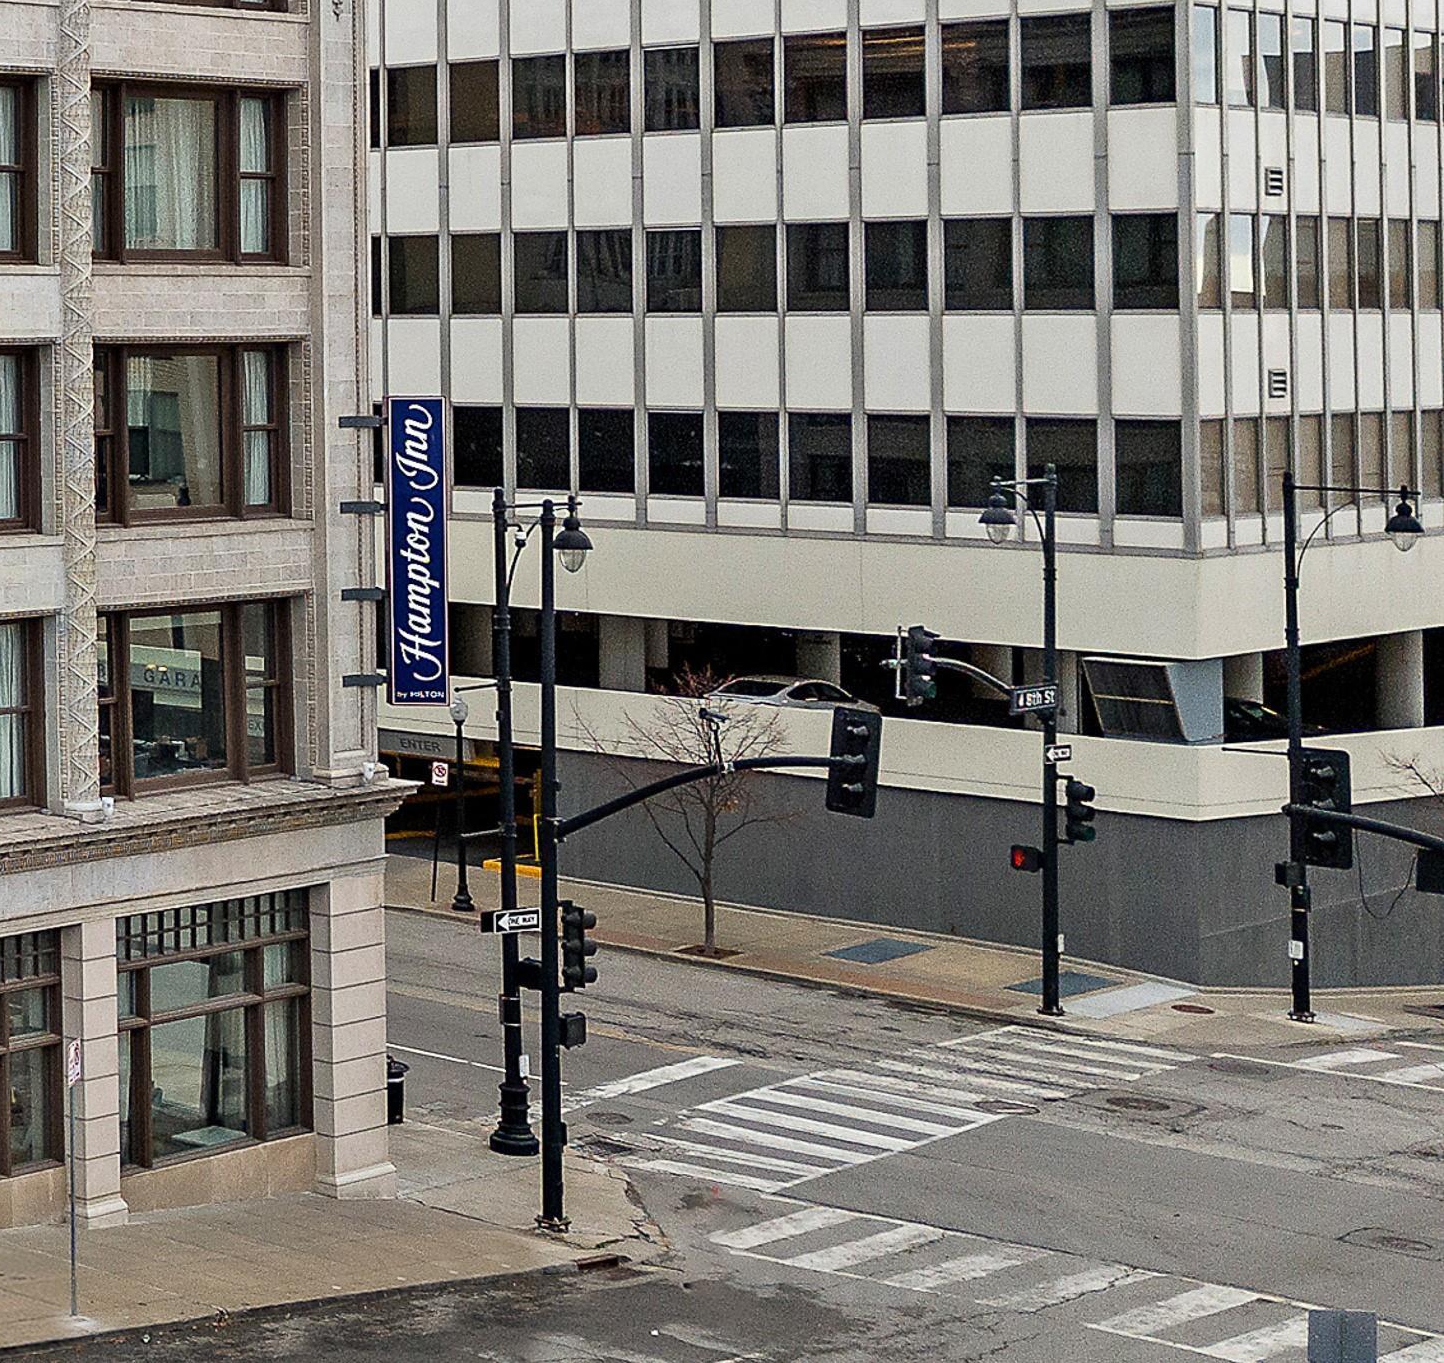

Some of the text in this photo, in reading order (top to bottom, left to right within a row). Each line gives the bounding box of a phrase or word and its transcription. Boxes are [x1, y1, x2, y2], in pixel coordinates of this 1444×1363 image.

[395, 403, 442, 681] Hampton Inn
[399, 738, 441, 753] ENTER
